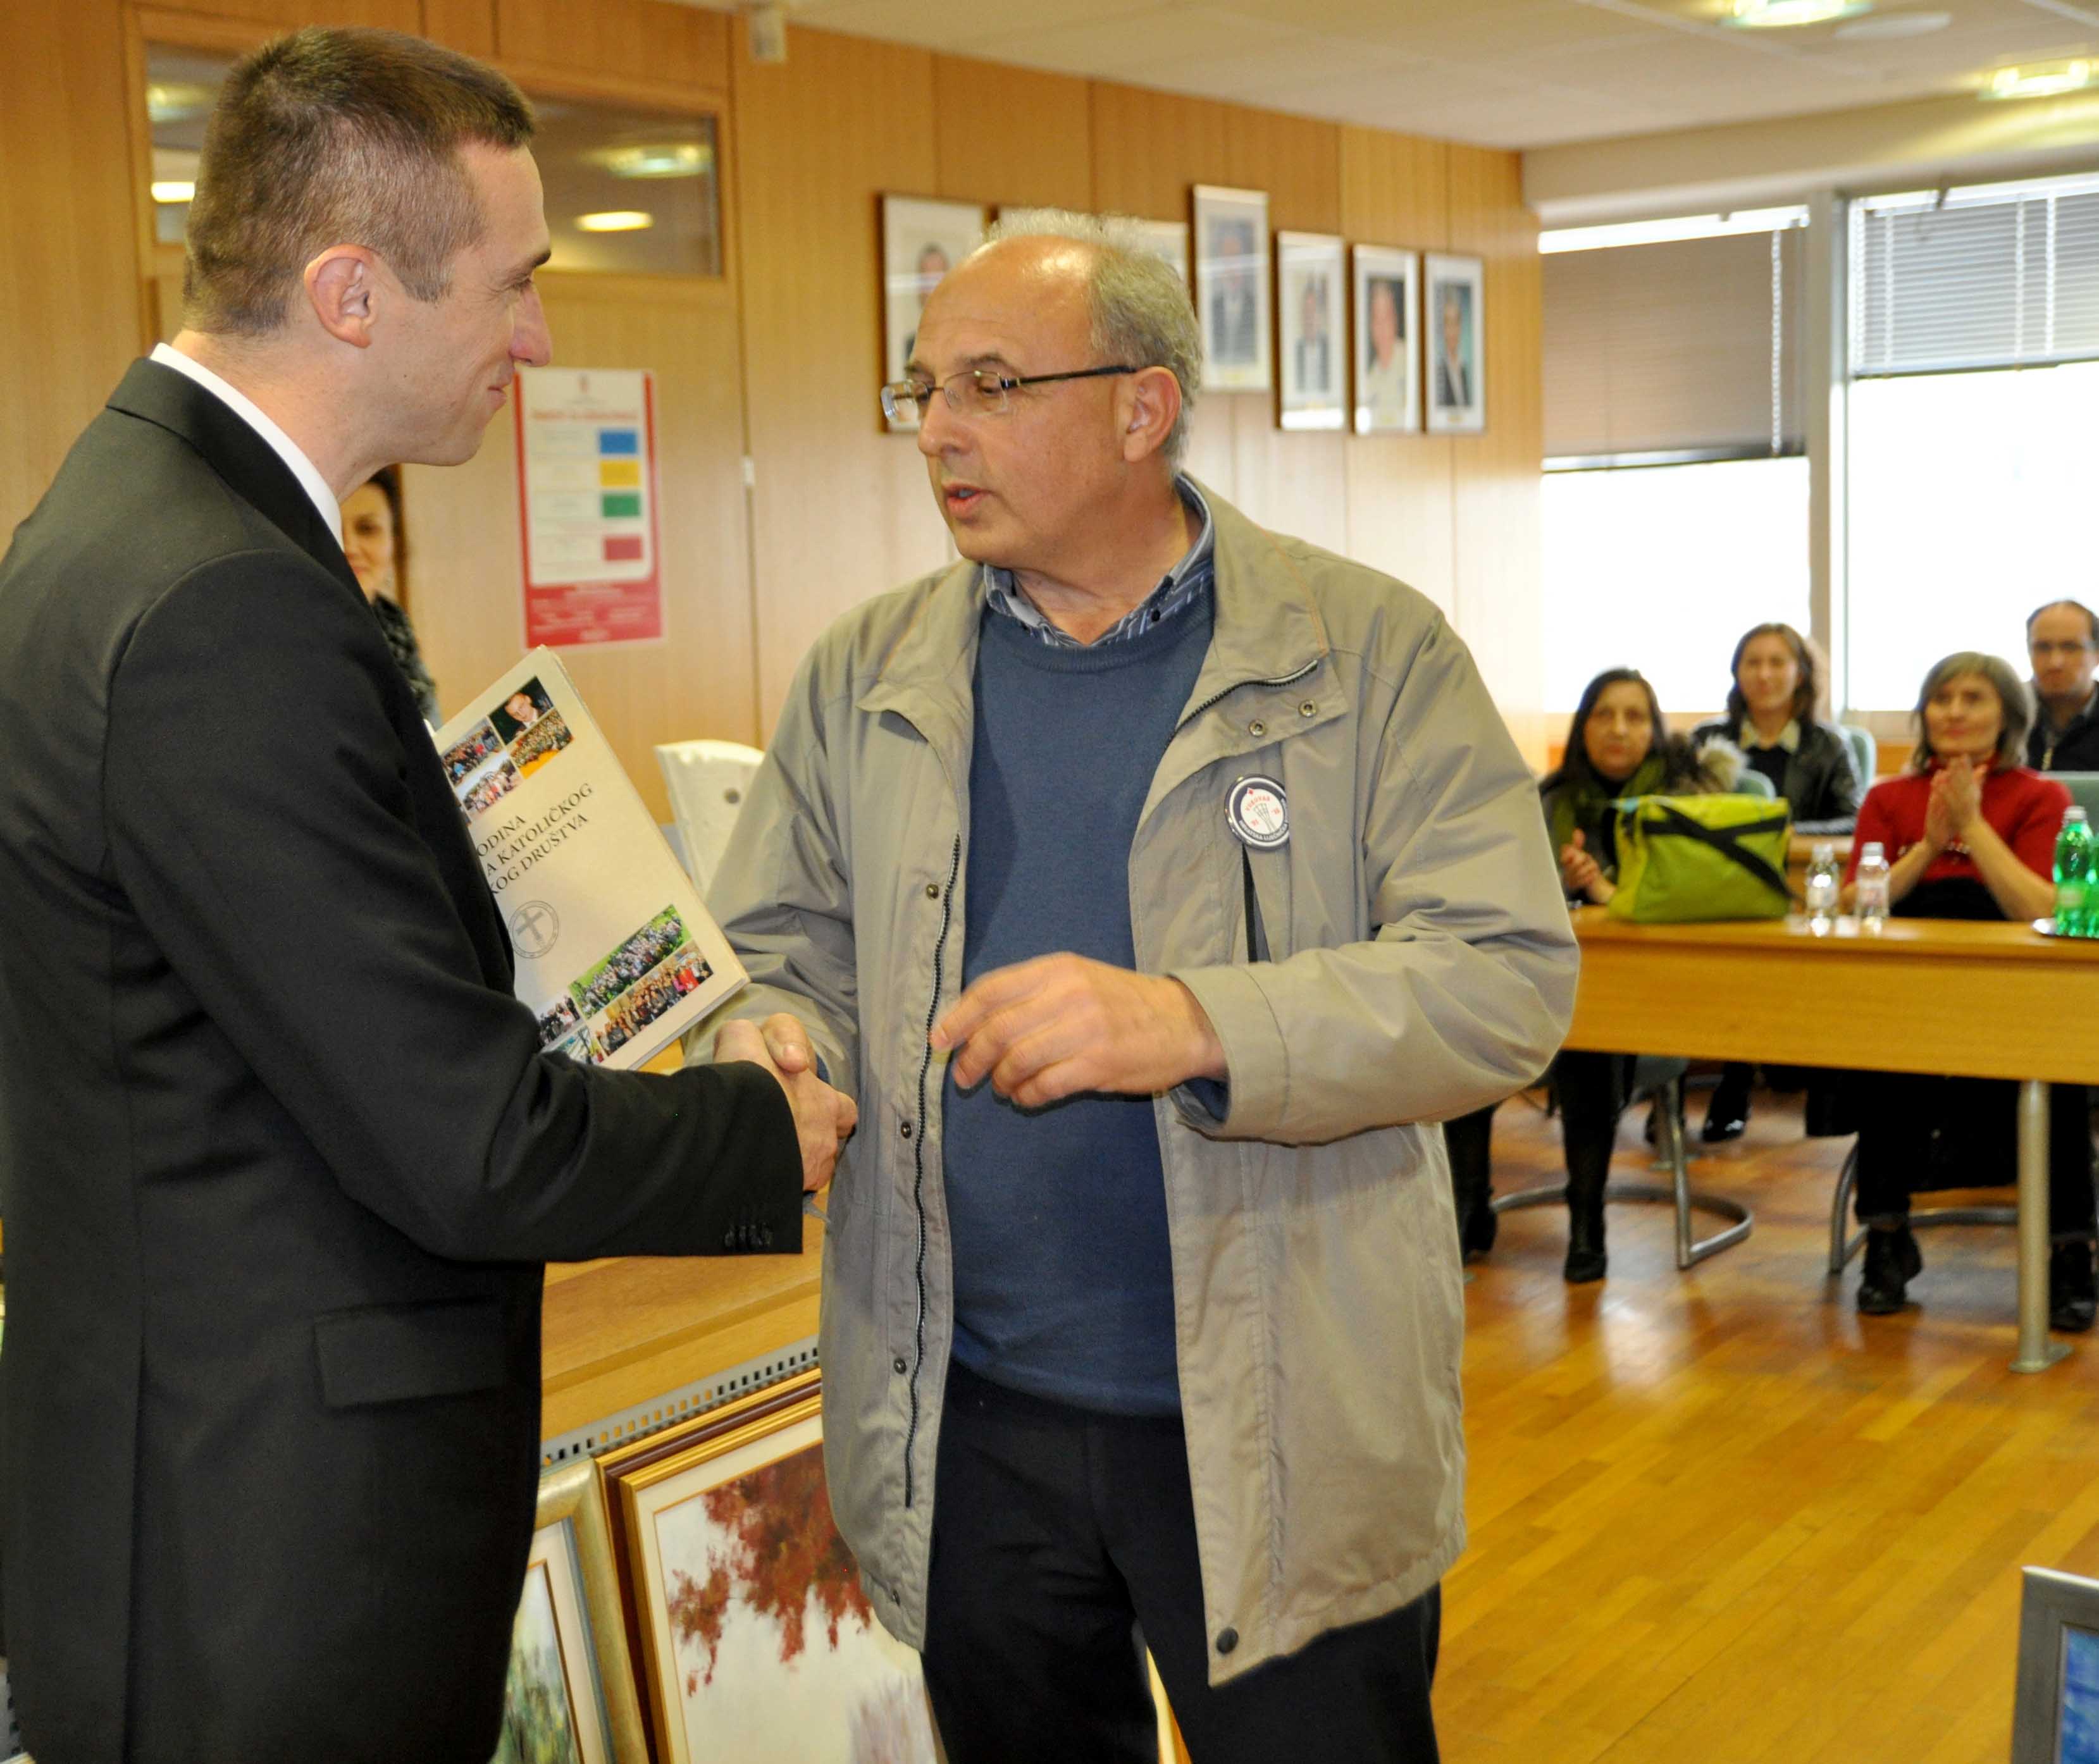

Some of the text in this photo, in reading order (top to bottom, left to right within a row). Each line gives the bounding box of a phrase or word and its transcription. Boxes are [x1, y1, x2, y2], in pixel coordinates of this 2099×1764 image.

[476, 815, 526, 857] ODINA
[490, 813, 588, 894] KOG DRUŠTVA
[497, 782, 593, 865] KATOLIČKOG
